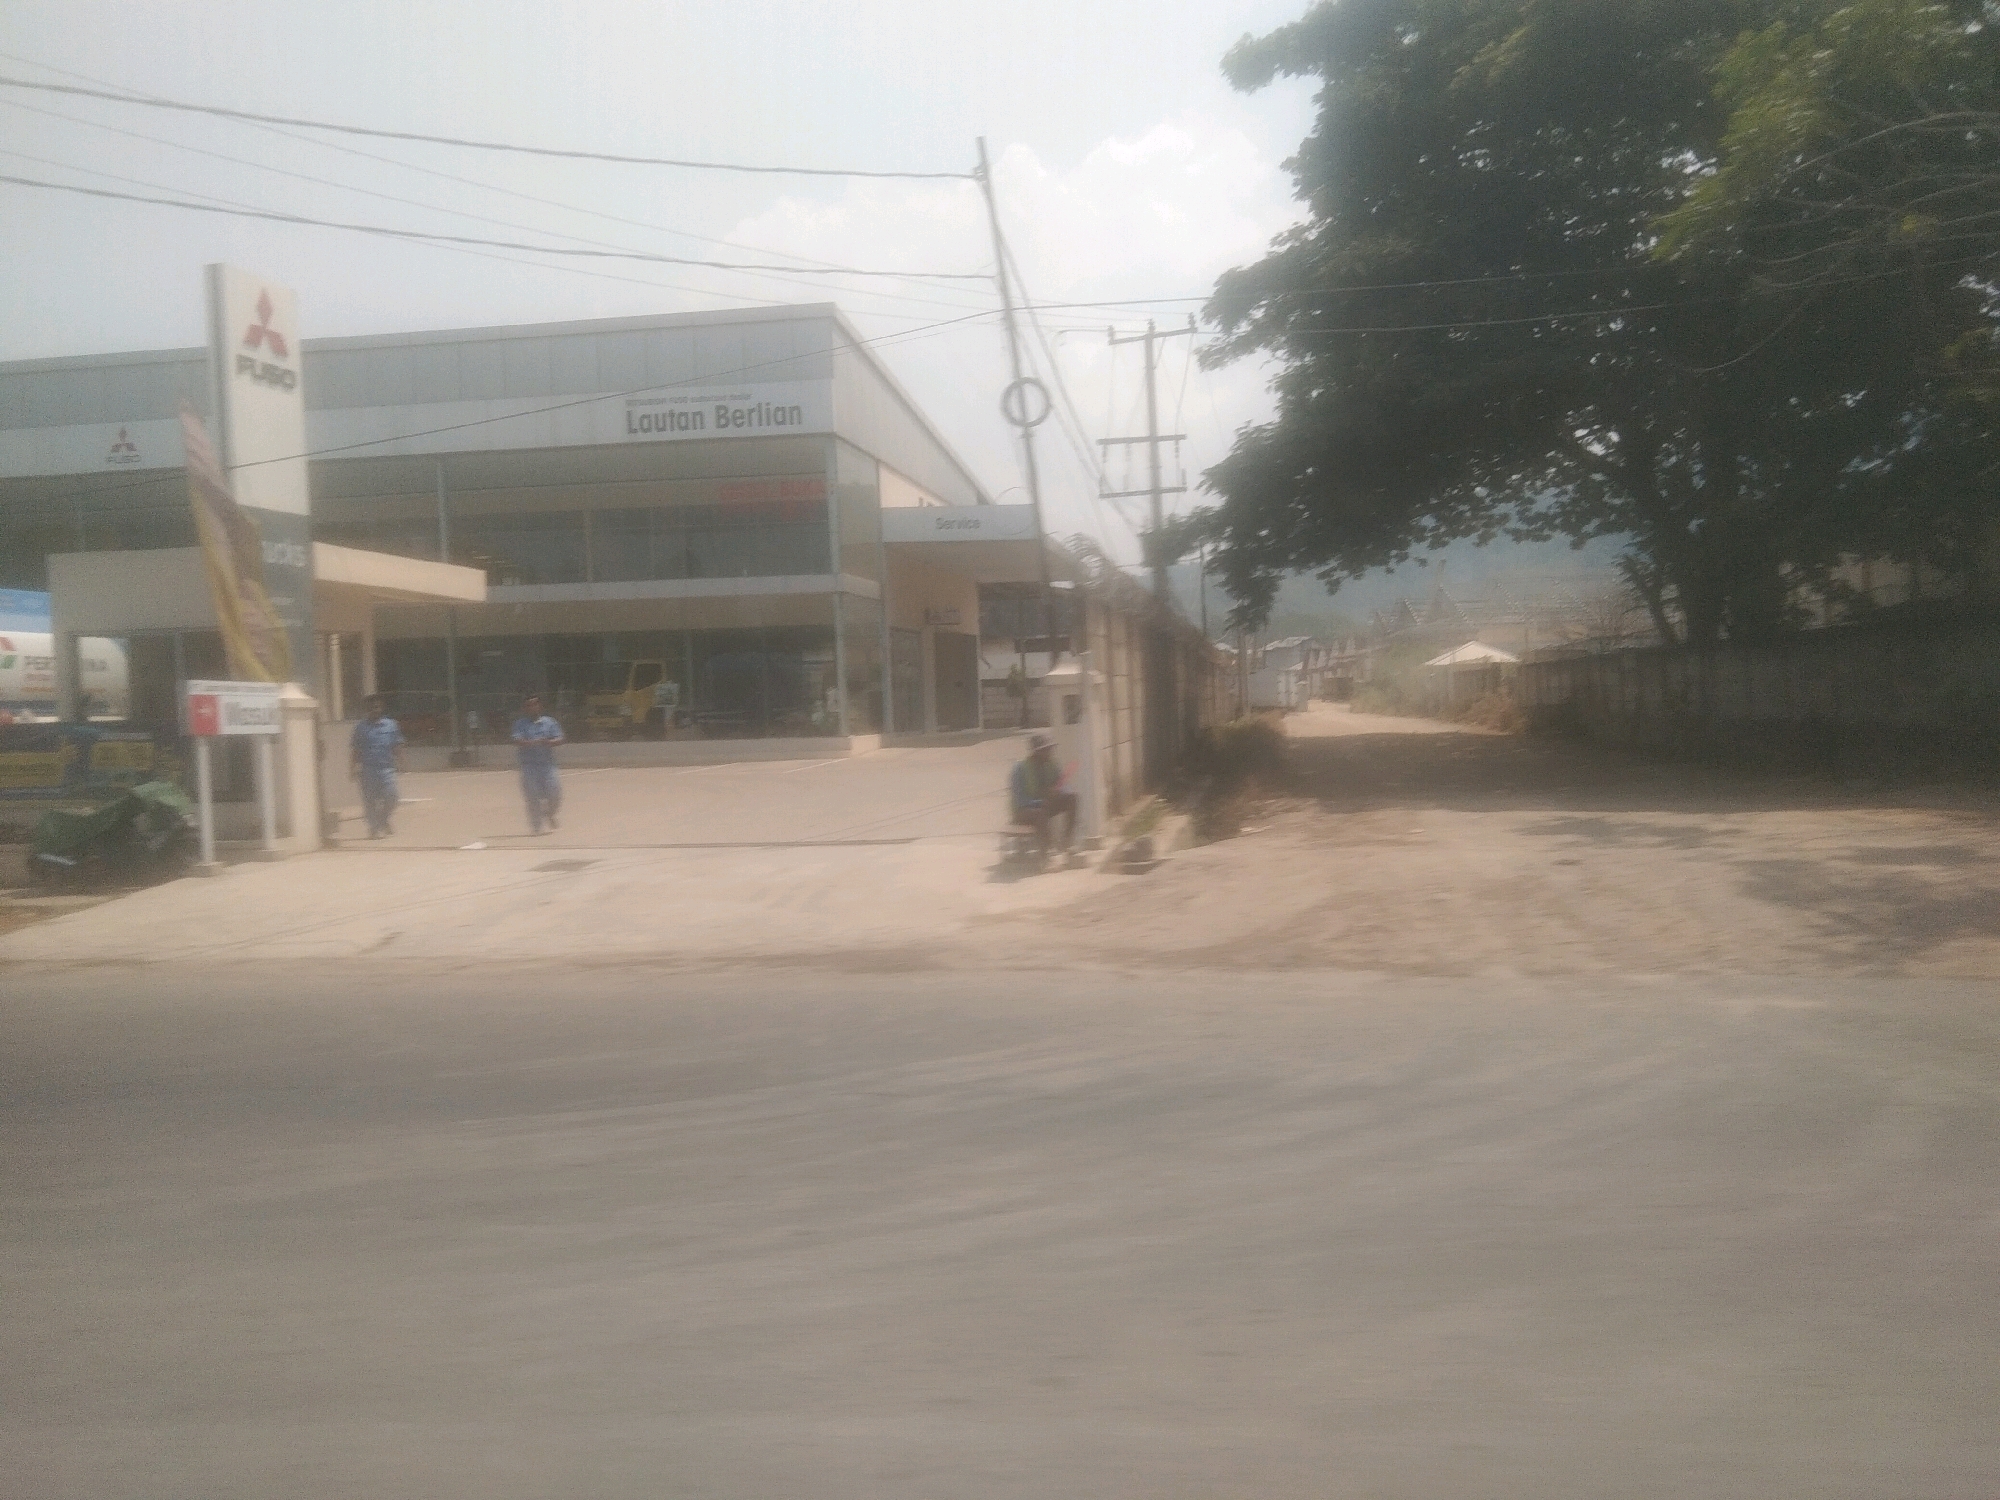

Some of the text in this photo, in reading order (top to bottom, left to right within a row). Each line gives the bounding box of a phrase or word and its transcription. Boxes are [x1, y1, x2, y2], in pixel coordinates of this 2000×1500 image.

[626, 402, 802, 434] Lautan Berlian
[935, 517, 980, 530] Service
